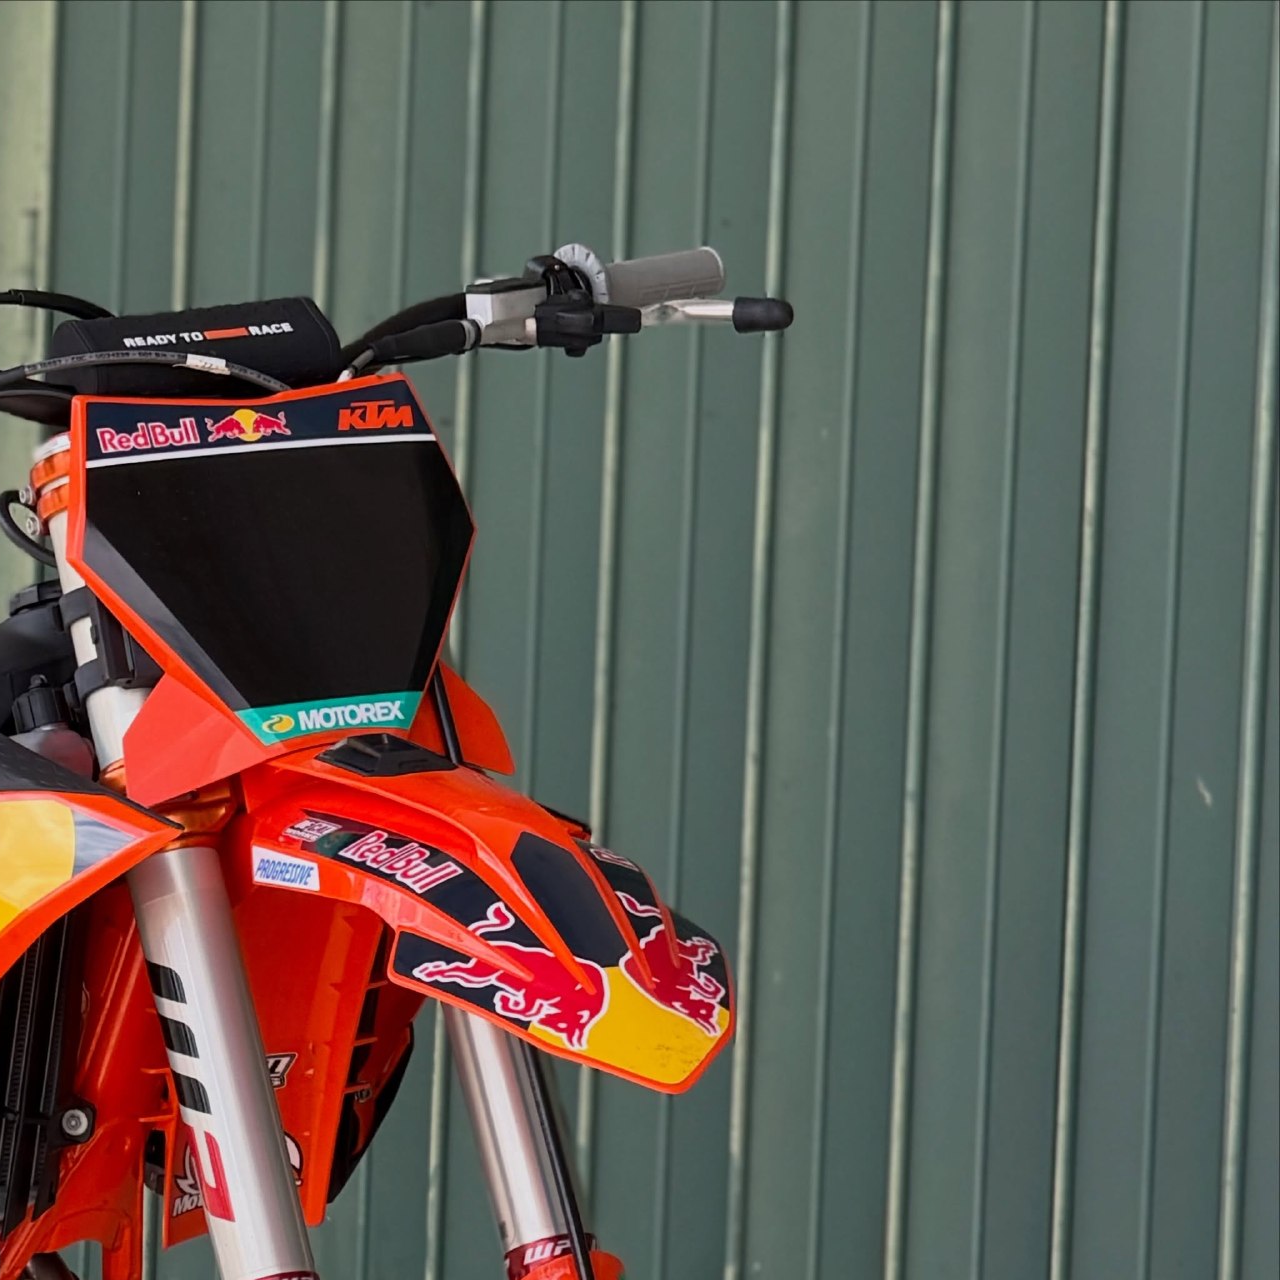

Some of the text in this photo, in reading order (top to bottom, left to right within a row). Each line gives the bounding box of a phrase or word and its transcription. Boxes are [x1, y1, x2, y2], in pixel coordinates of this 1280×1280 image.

[123, 322, 294, 349] READY TO RACE
[337, 400, 414, 431] KTM
[298, 700, 407, 732] MOTOREX
[256, 859, 315, 886] PROGRESSIVE
[523, 1239, 571, 1266] WP
